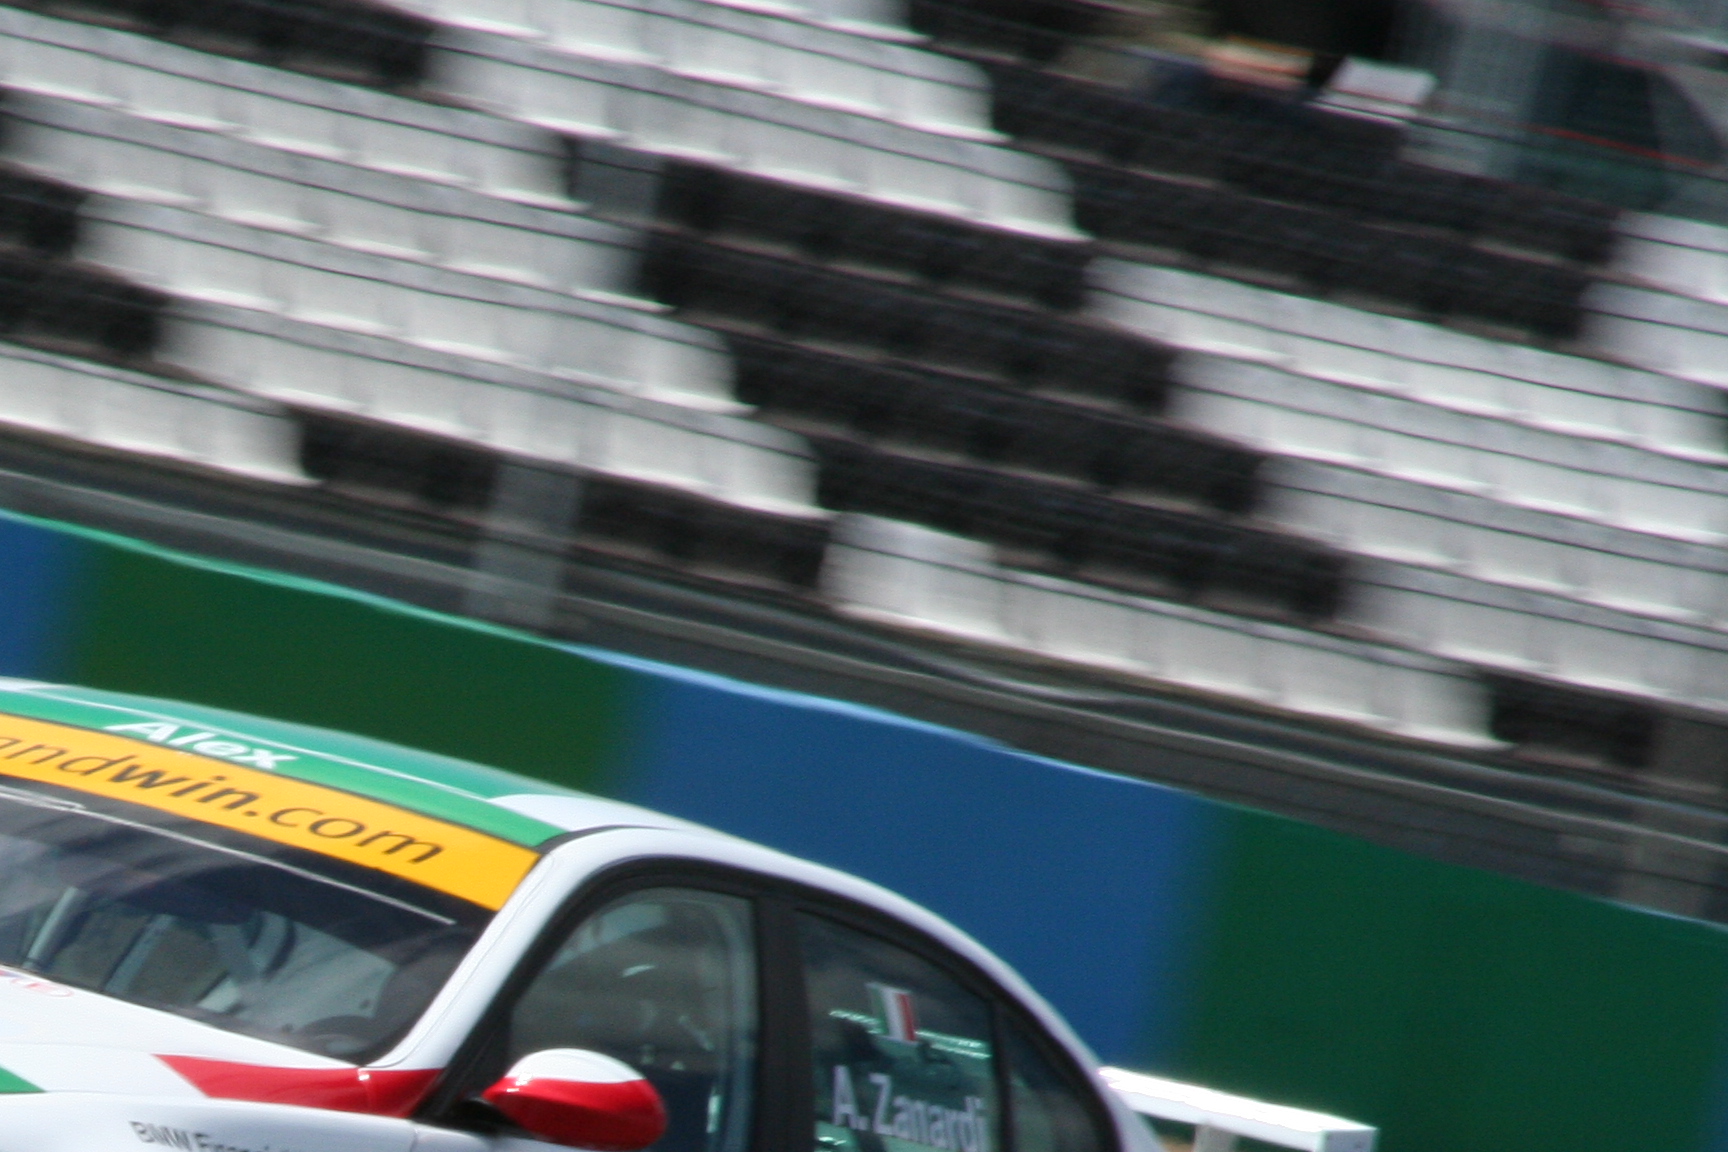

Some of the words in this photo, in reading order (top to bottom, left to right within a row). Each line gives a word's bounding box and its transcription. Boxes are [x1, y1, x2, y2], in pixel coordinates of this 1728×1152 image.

[103, 721, 299, 769] Alex
[833, 1065, 869, 1131] A.
[130, 1121, 192, 1152] BMW
